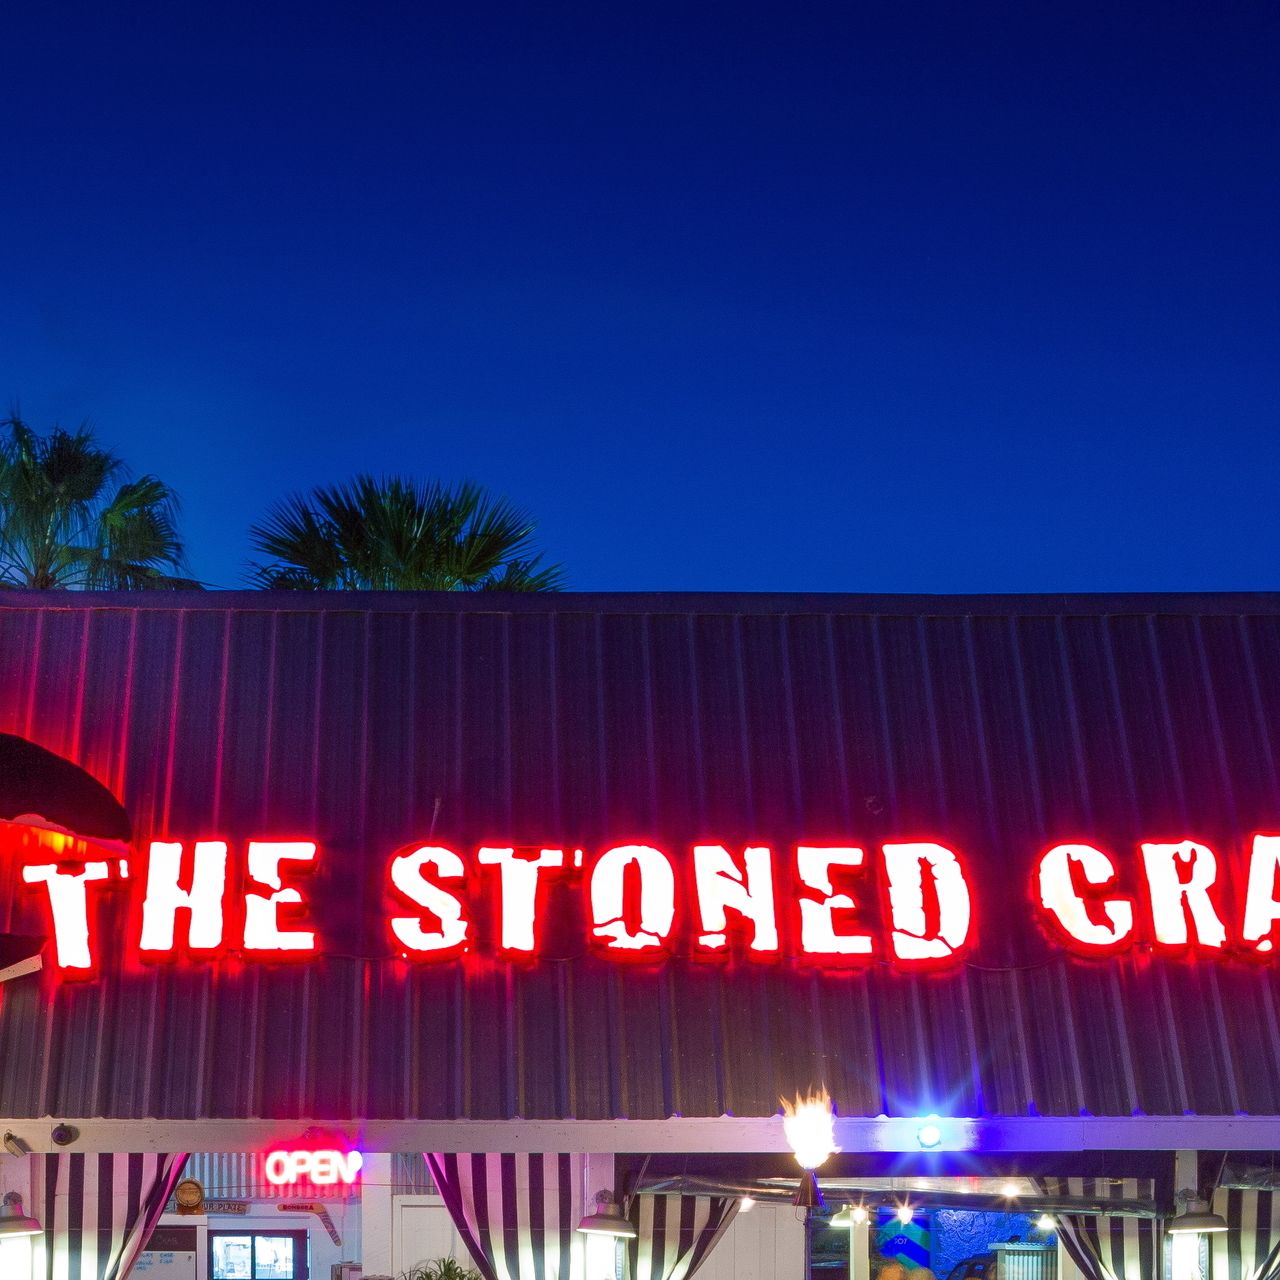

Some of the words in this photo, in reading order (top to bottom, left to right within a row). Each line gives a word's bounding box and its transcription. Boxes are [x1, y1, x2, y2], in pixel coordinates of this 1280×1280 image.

[22, 841, 317, 969] THE
[390, 842, 971, 960] STONED
[266, 1151, 362, 1184] OPEN
